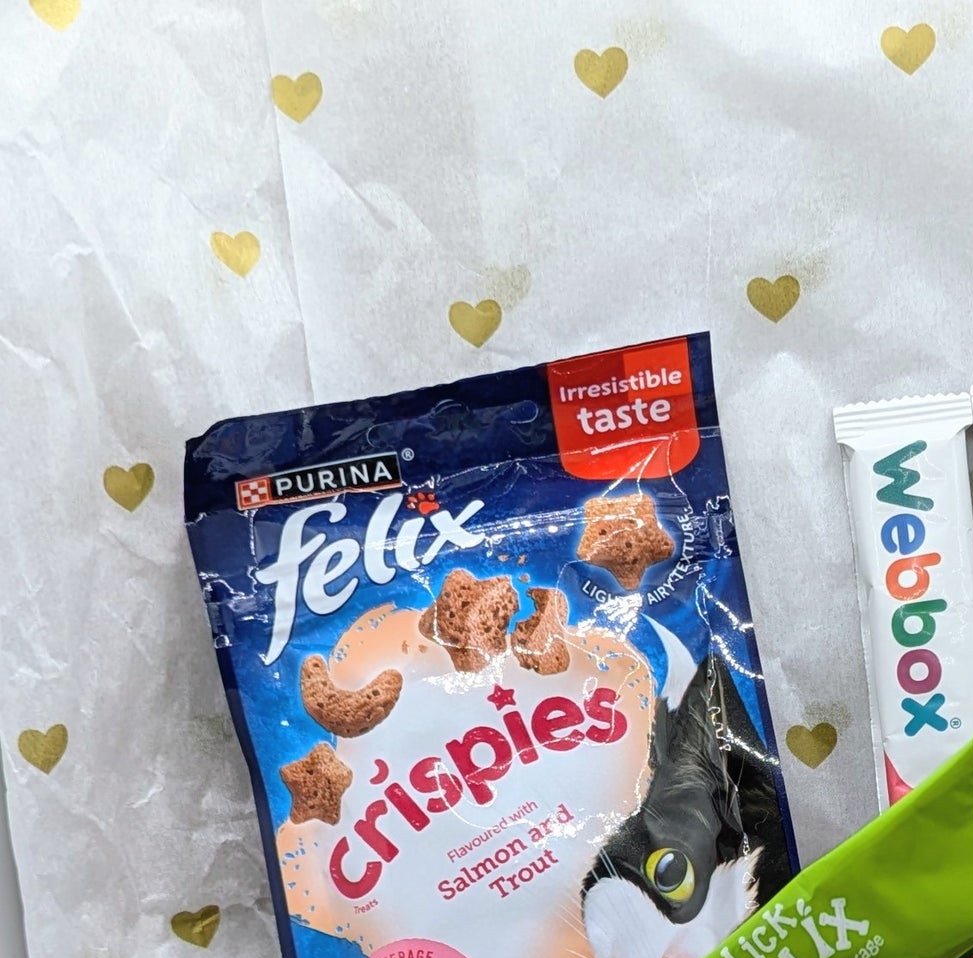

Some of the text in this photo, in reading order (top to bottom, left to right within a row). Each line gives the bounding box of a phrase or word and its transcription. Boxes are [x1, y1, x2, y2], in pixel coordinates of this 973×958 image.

[559, 367, 682, 404] Irresistible
[577, 397, 671, 436] taste
[275, 460, 393, 497] PURINA
[646, 578, 676, 606] AIRY
[874, 440, 948, 736] Webbox
[447, 801, 538, 863] Flavoured with
[438, 838, 528, 900] Salmon
[489, 849, 558, 898] Trout
[354, 898, 378, 915] Treats
